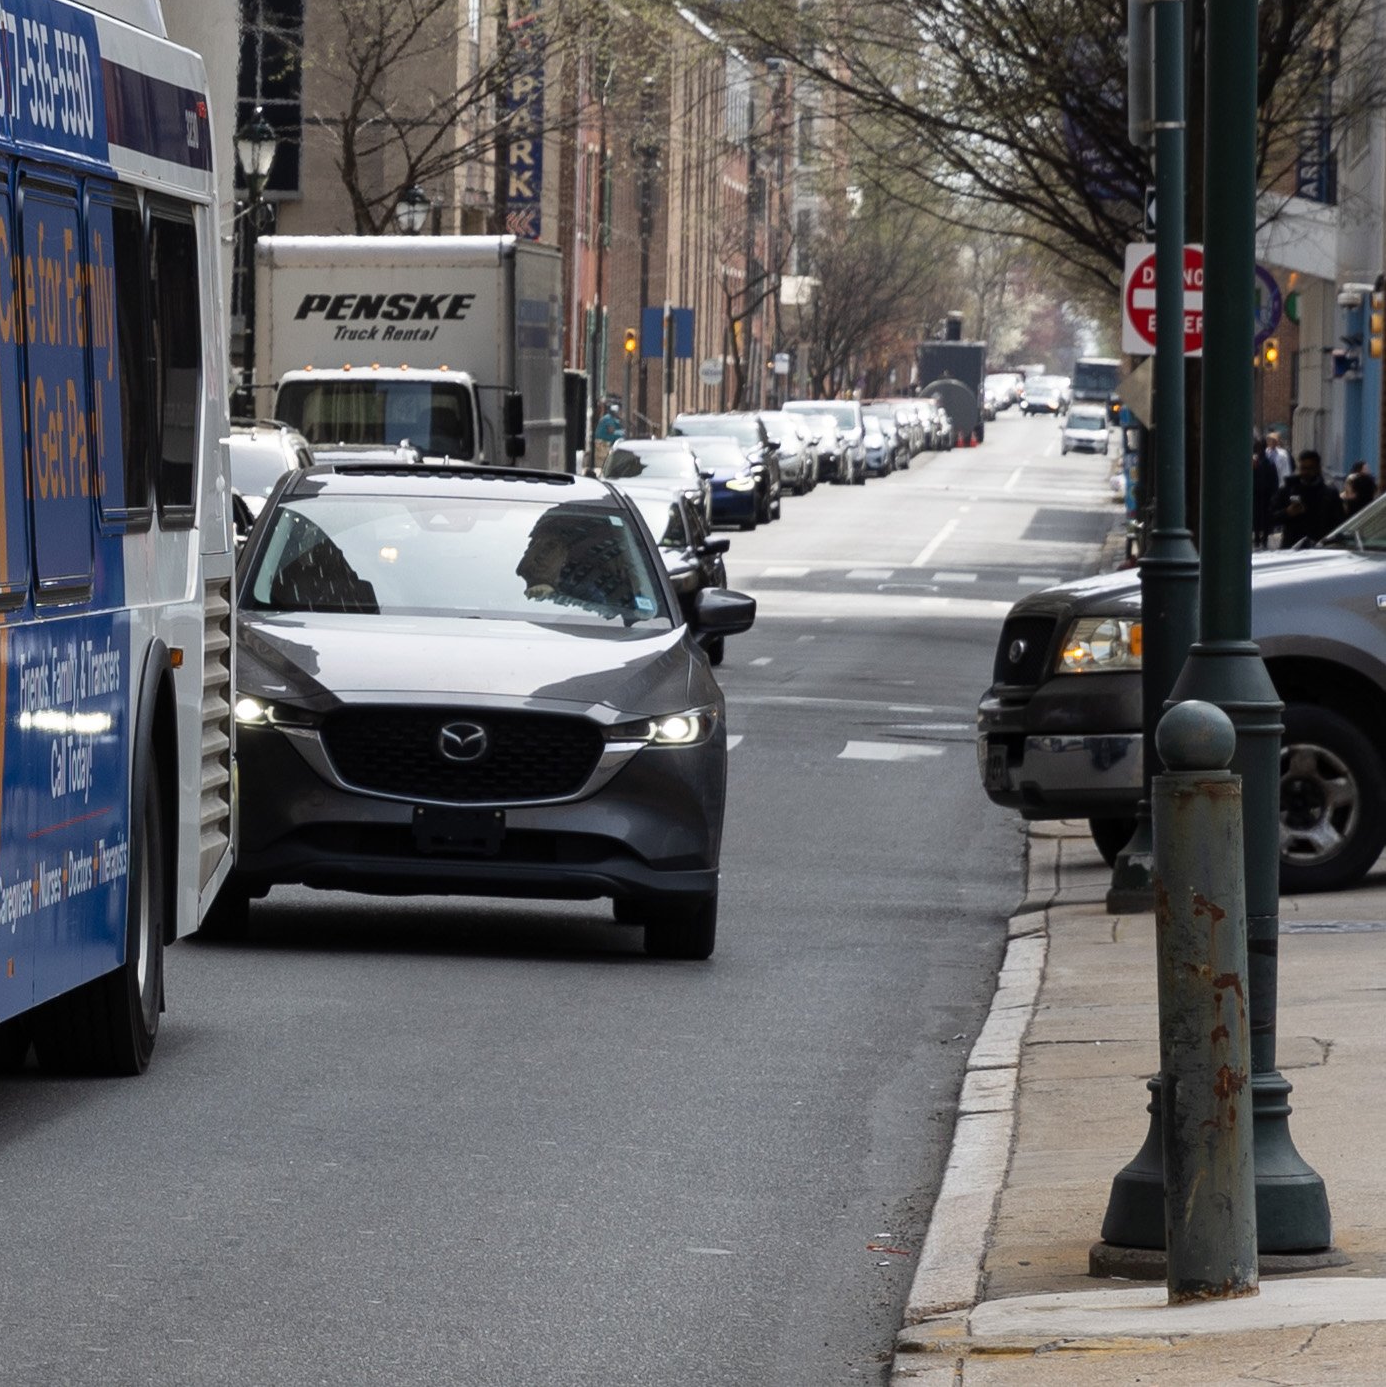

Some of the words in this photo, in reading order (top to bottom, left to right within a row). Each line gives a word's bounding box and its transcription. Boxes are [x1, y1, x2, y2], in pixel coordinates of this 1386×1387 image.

[507, 73, 535, 198] PARK
[37, 220, 62, 345] for
[294, 293, 476, 321] PENSKE
[333, 325, 379, 341] Truck
[381, 325, 440, 342] Rental
[34, 375, 66, 500] Get
[80, 640, 87, 700] &
[50, 737, 67, 800] Call
[39, 860, 62, 910] Nurses
[68, 849, 93, 898] Doctors
